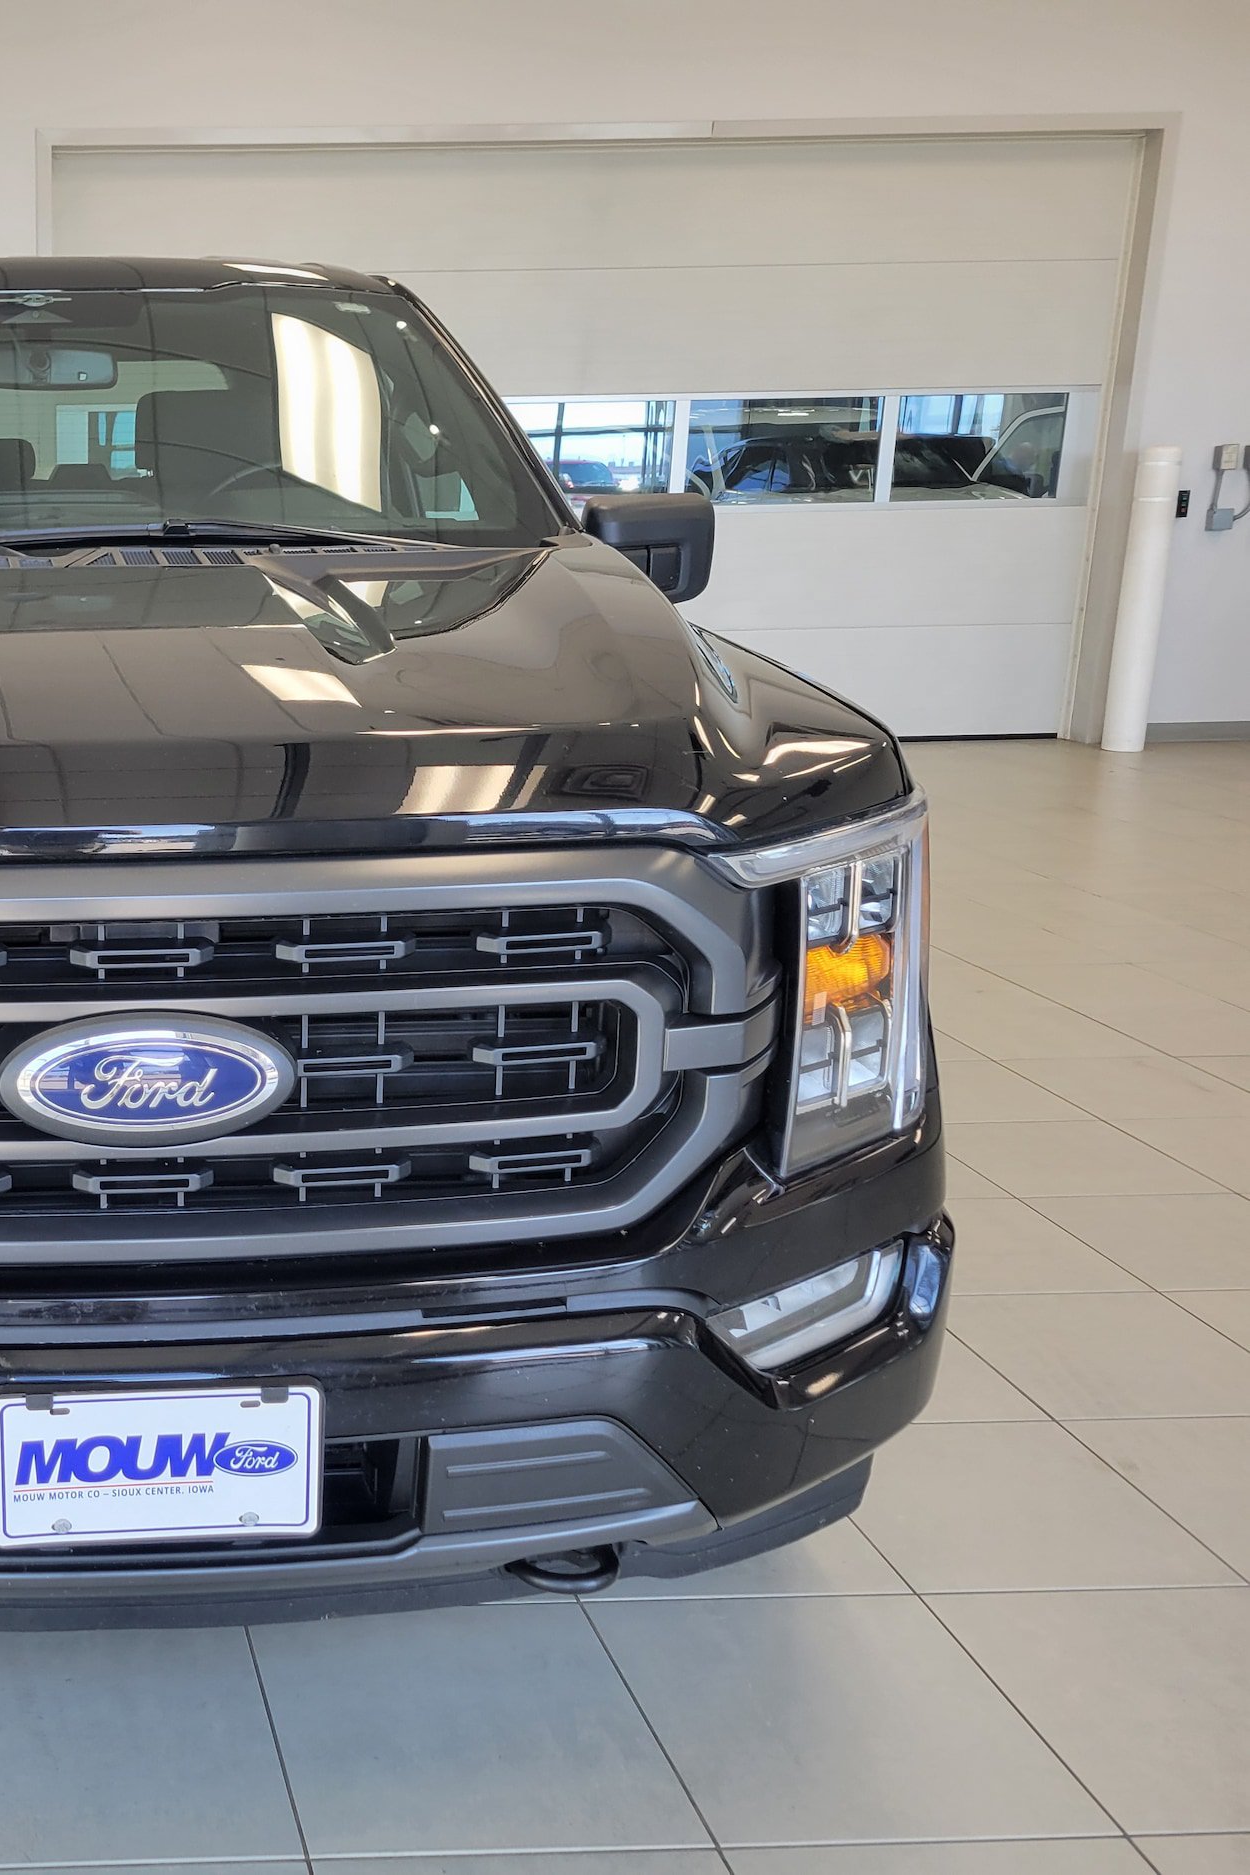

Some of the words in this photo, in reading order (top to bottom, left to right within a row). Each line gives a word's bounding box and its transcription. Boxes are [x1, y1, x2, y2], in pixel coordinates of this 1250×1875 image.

[80, 1054, 218, 1109] Ford
[15, 1432, 231, 1486] MOUW
[230, 1445, 280, 1470] Ford
[13, 1492, 45, 1503] MOUW
[49, 1490, 84, 1501] MOTOR
[87, 1489, 100, 1499] CO
[112, 1488, 142, 1498] SIOUX
[188, 1484, 214, 1494] IOWA
